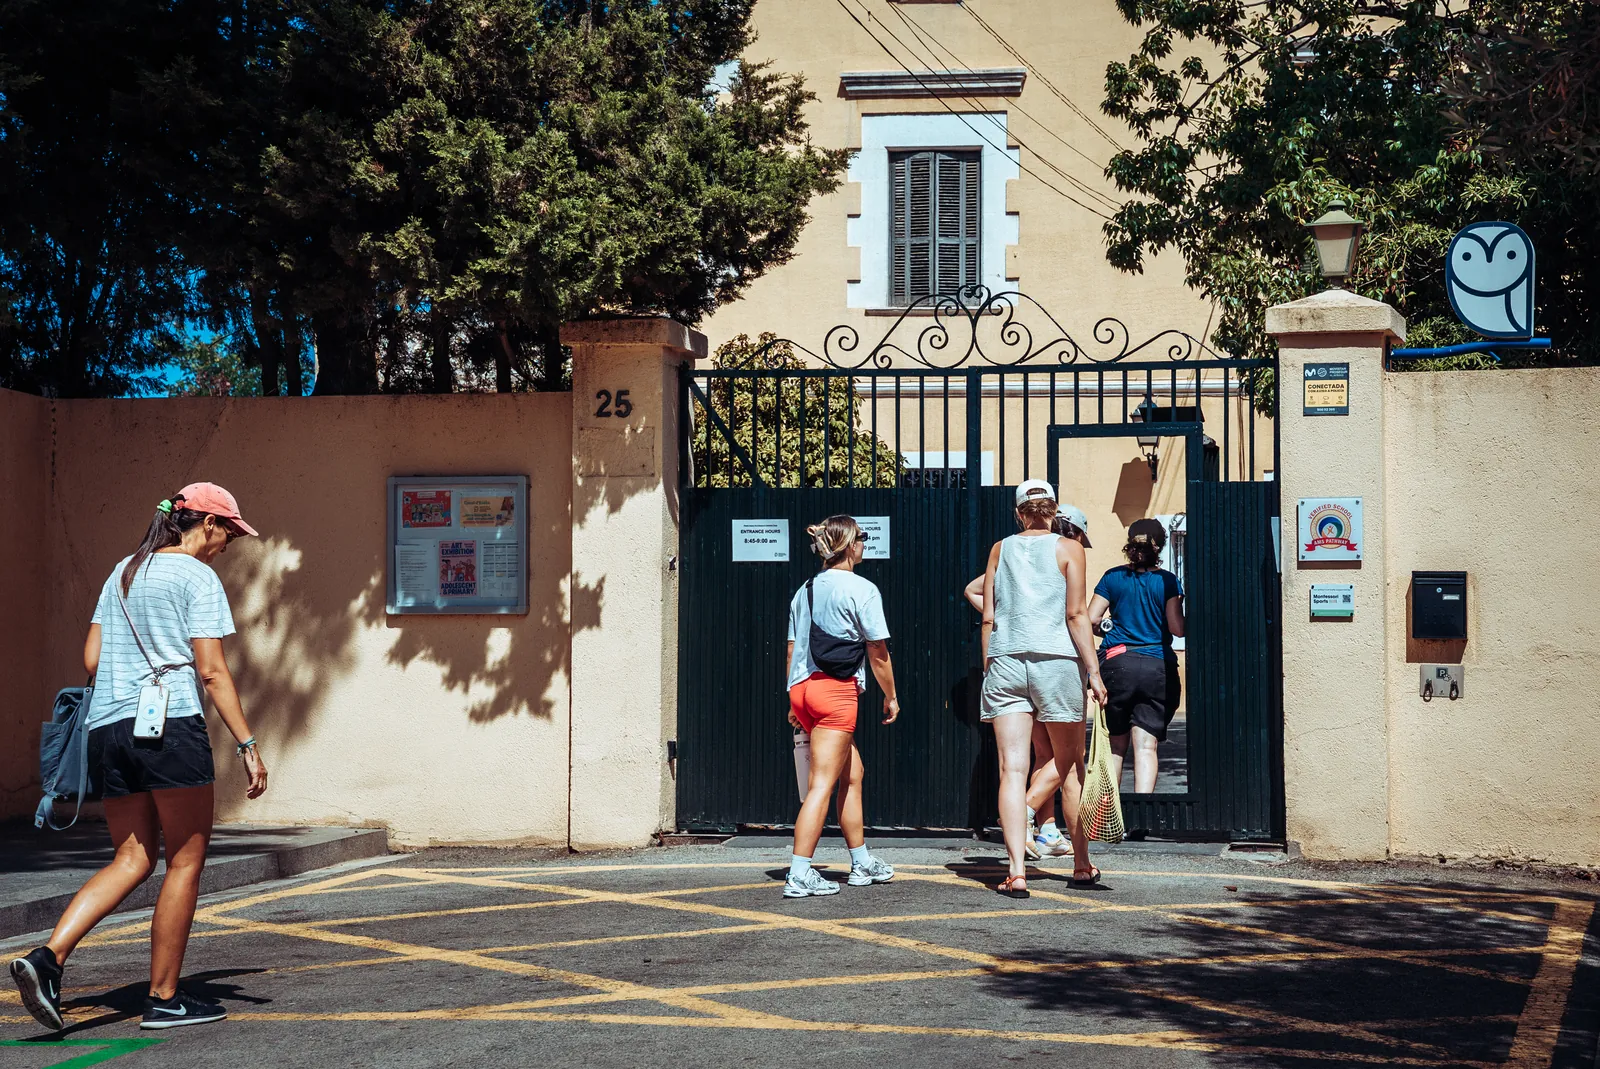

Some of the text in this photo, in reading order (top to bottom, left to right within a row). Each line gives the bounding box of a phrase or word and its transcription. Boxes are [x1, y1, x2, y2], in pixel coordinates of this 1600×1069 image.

[595, 389, 633, 418] 25
[1308, 504, 1353, 519] VERIFIED SCHOOL
[1439, 669, 1446, 677] P
